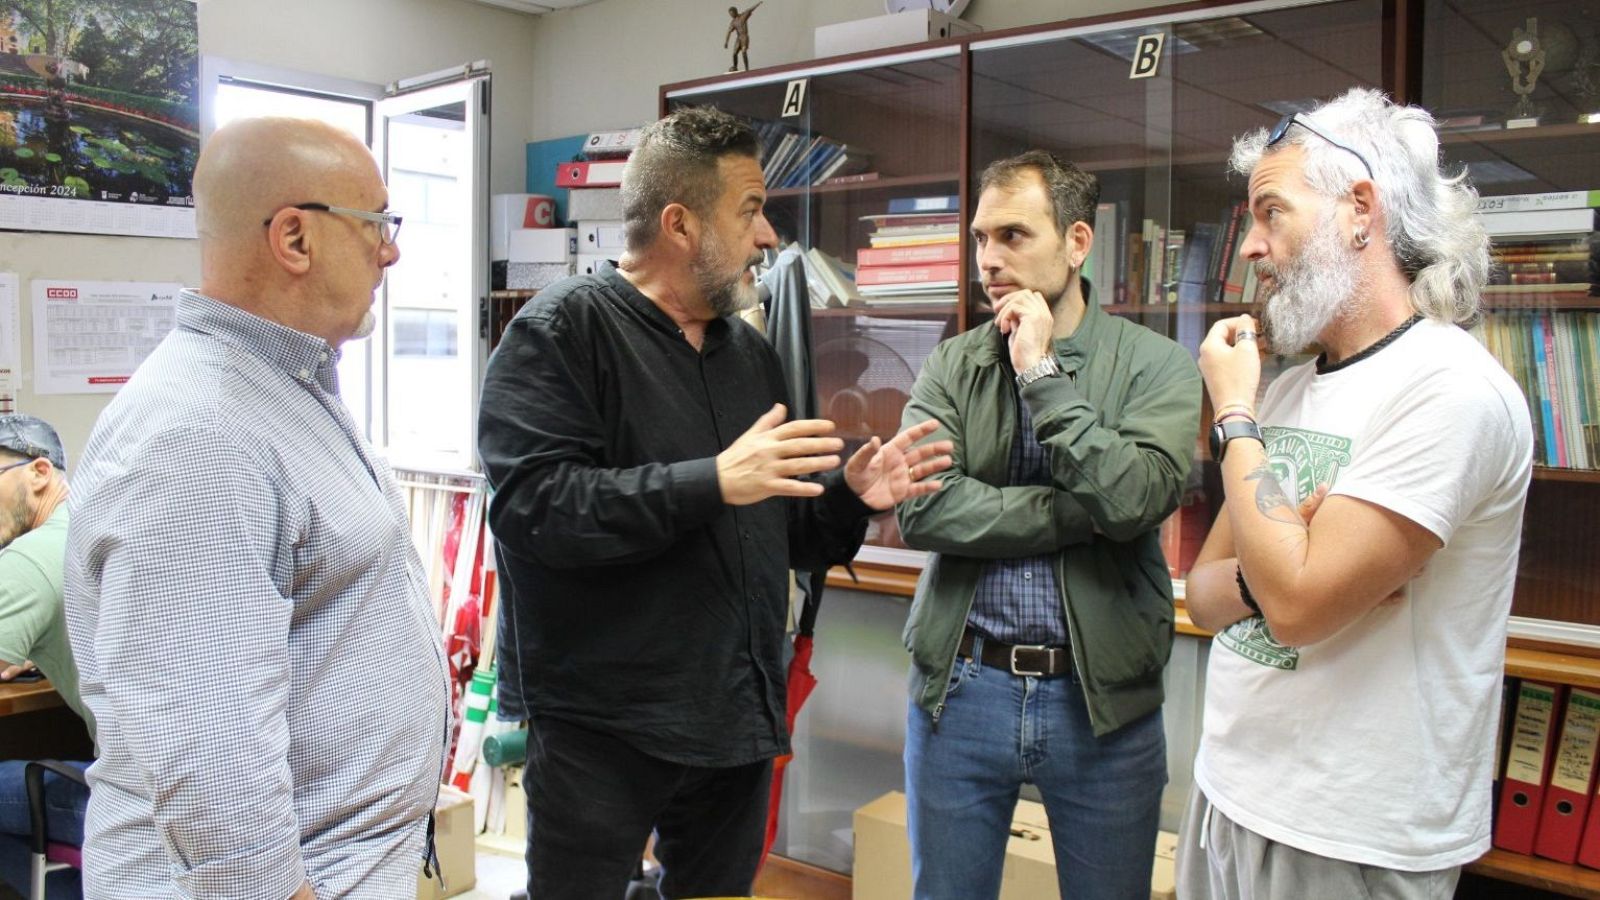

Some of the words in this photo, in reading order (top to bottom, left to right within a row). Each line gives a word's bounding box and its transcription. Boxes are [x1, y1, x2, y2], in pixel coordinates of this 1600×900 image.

[1134, 37, 1159, 75] B
[785, 83, 801, 114] A
[50, 185, 77, 197] 2024
[48, 289, 77, 298] CCOO
